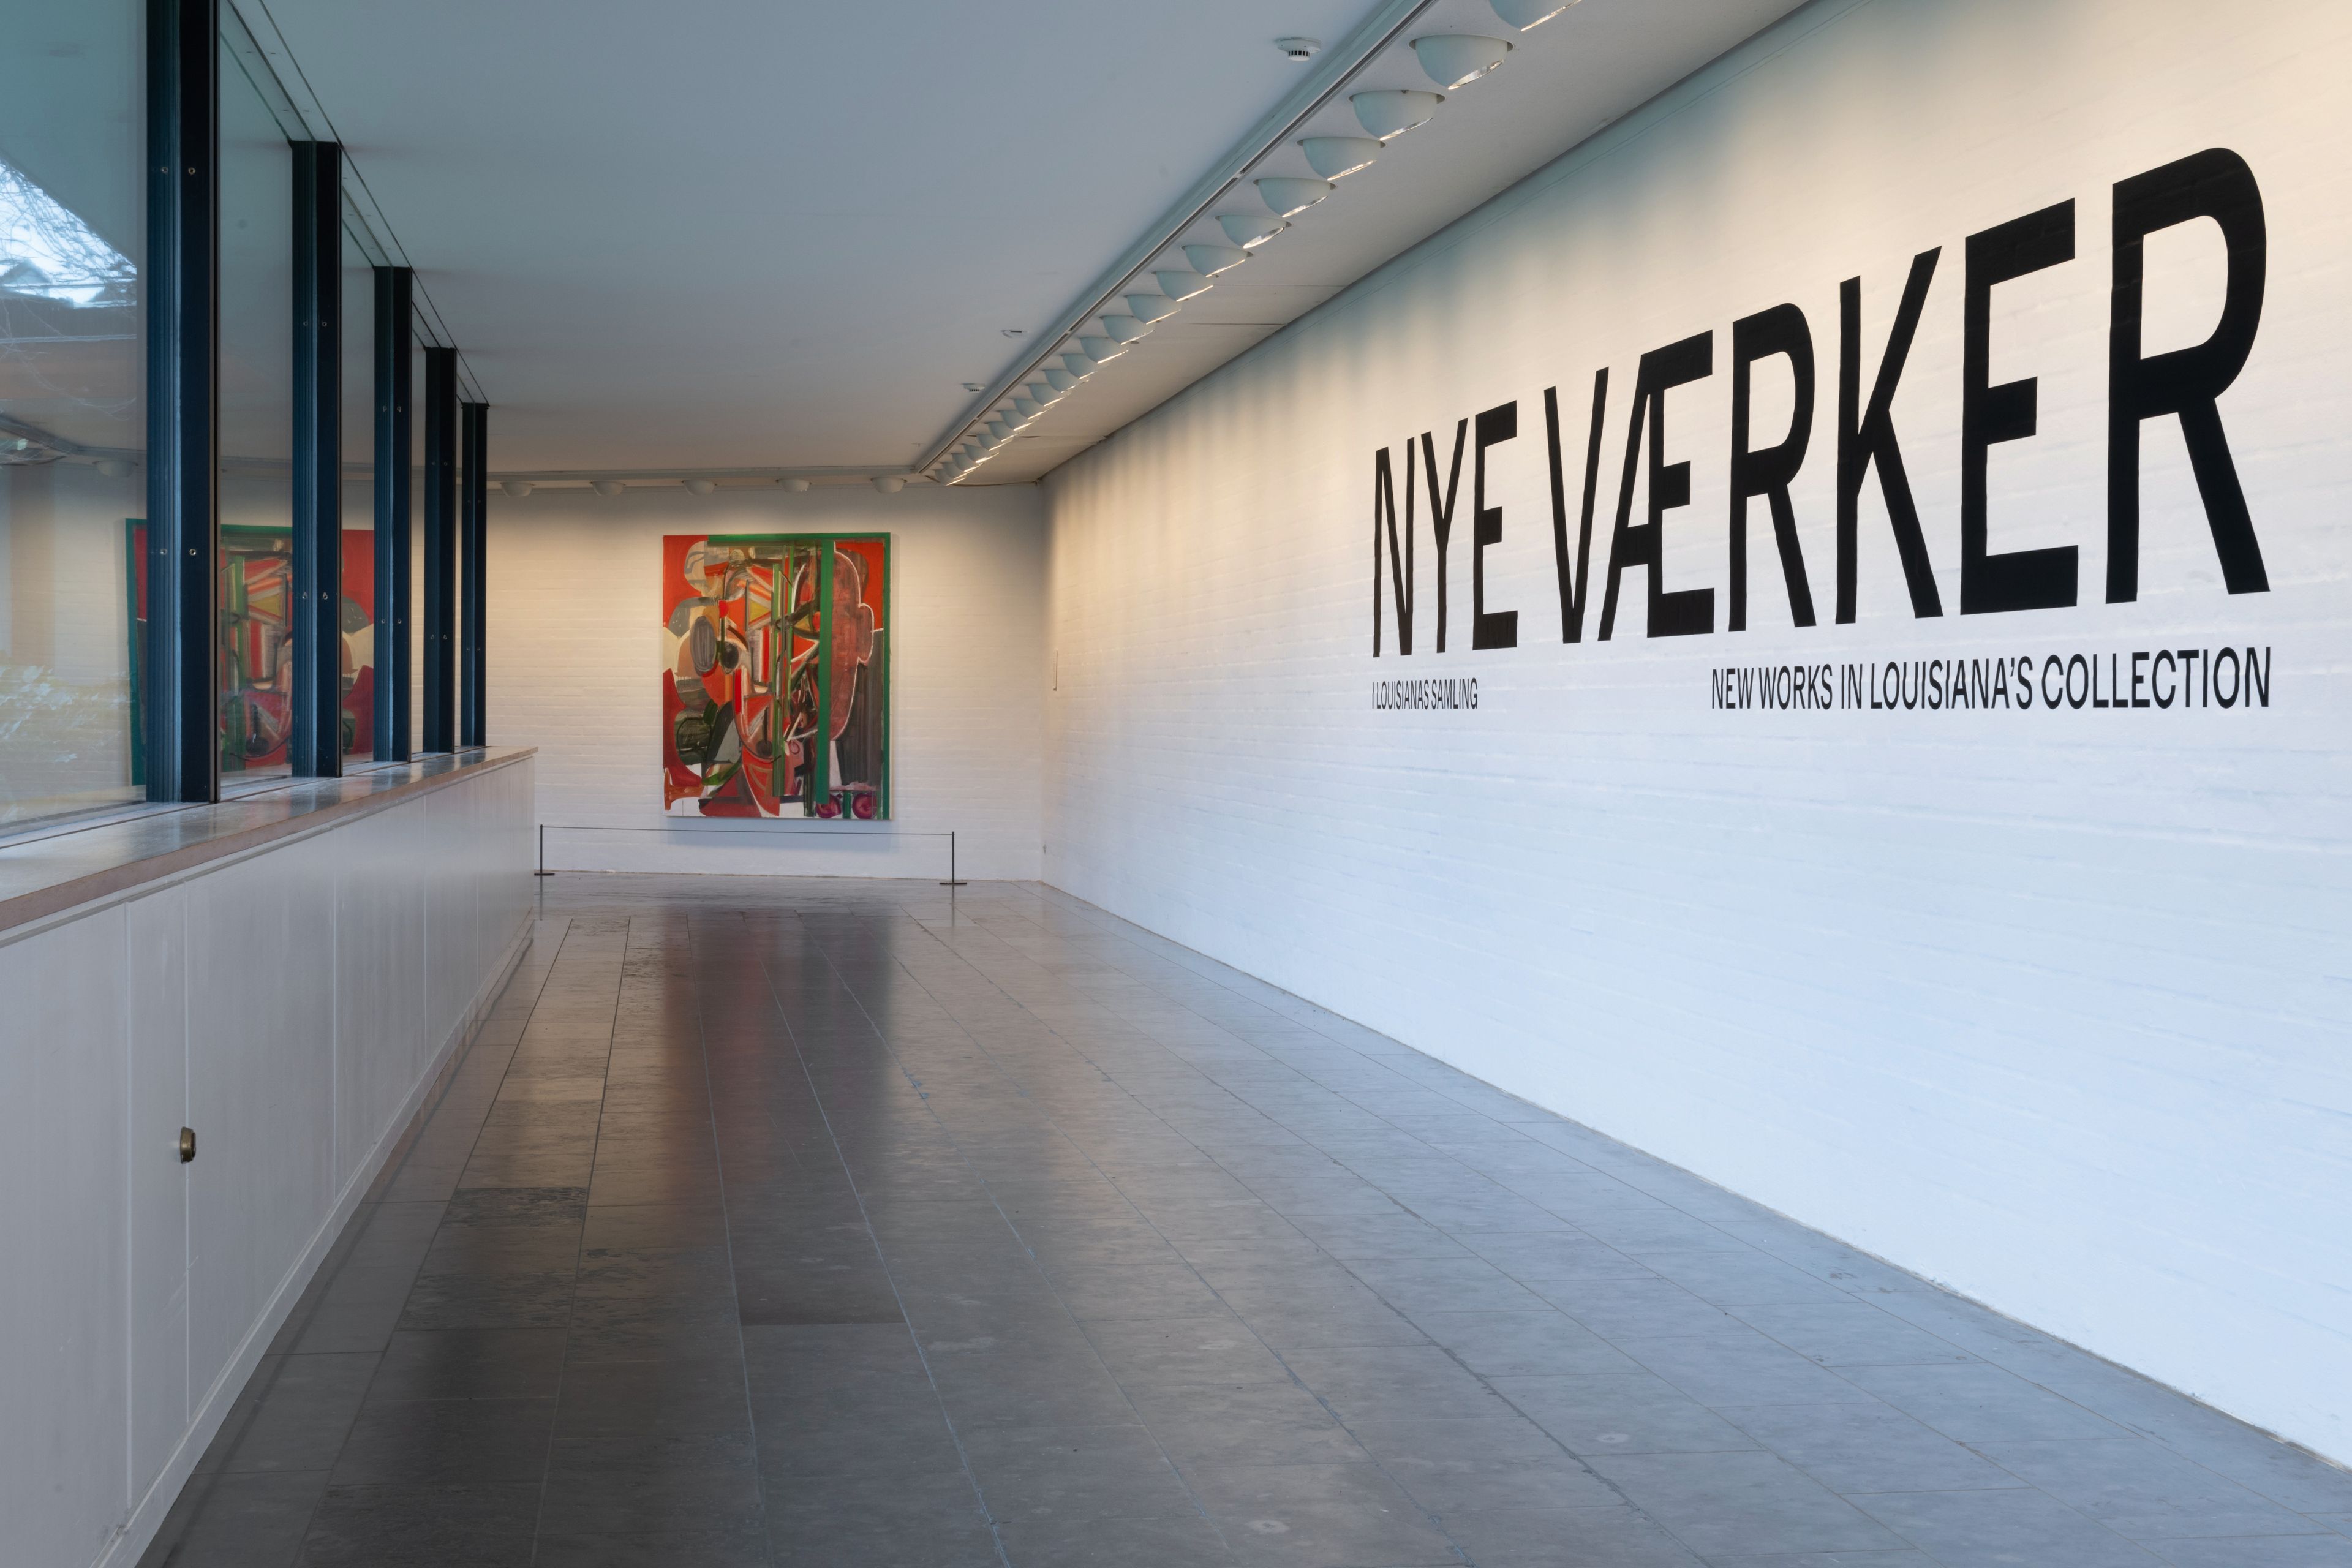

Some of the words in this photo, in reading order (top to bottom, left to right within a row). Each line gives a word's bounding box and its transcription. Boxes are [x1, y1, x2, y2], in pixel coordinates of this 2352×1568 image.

[1373, 401, 1518, 657] NYE
[1544, 148, 2271, 643] VÆRKER
[1376, 680, 1429, 709] LOUISIANAS
[1431, 677, 1478, 709] SAMLING
[1712, 668, 1754, 709] NEW
[1758, 664, 1833, 710] WORKS
[1841, 664, 1863, 709] IN
[2041, 646, 2271, 709] COLLECTION
